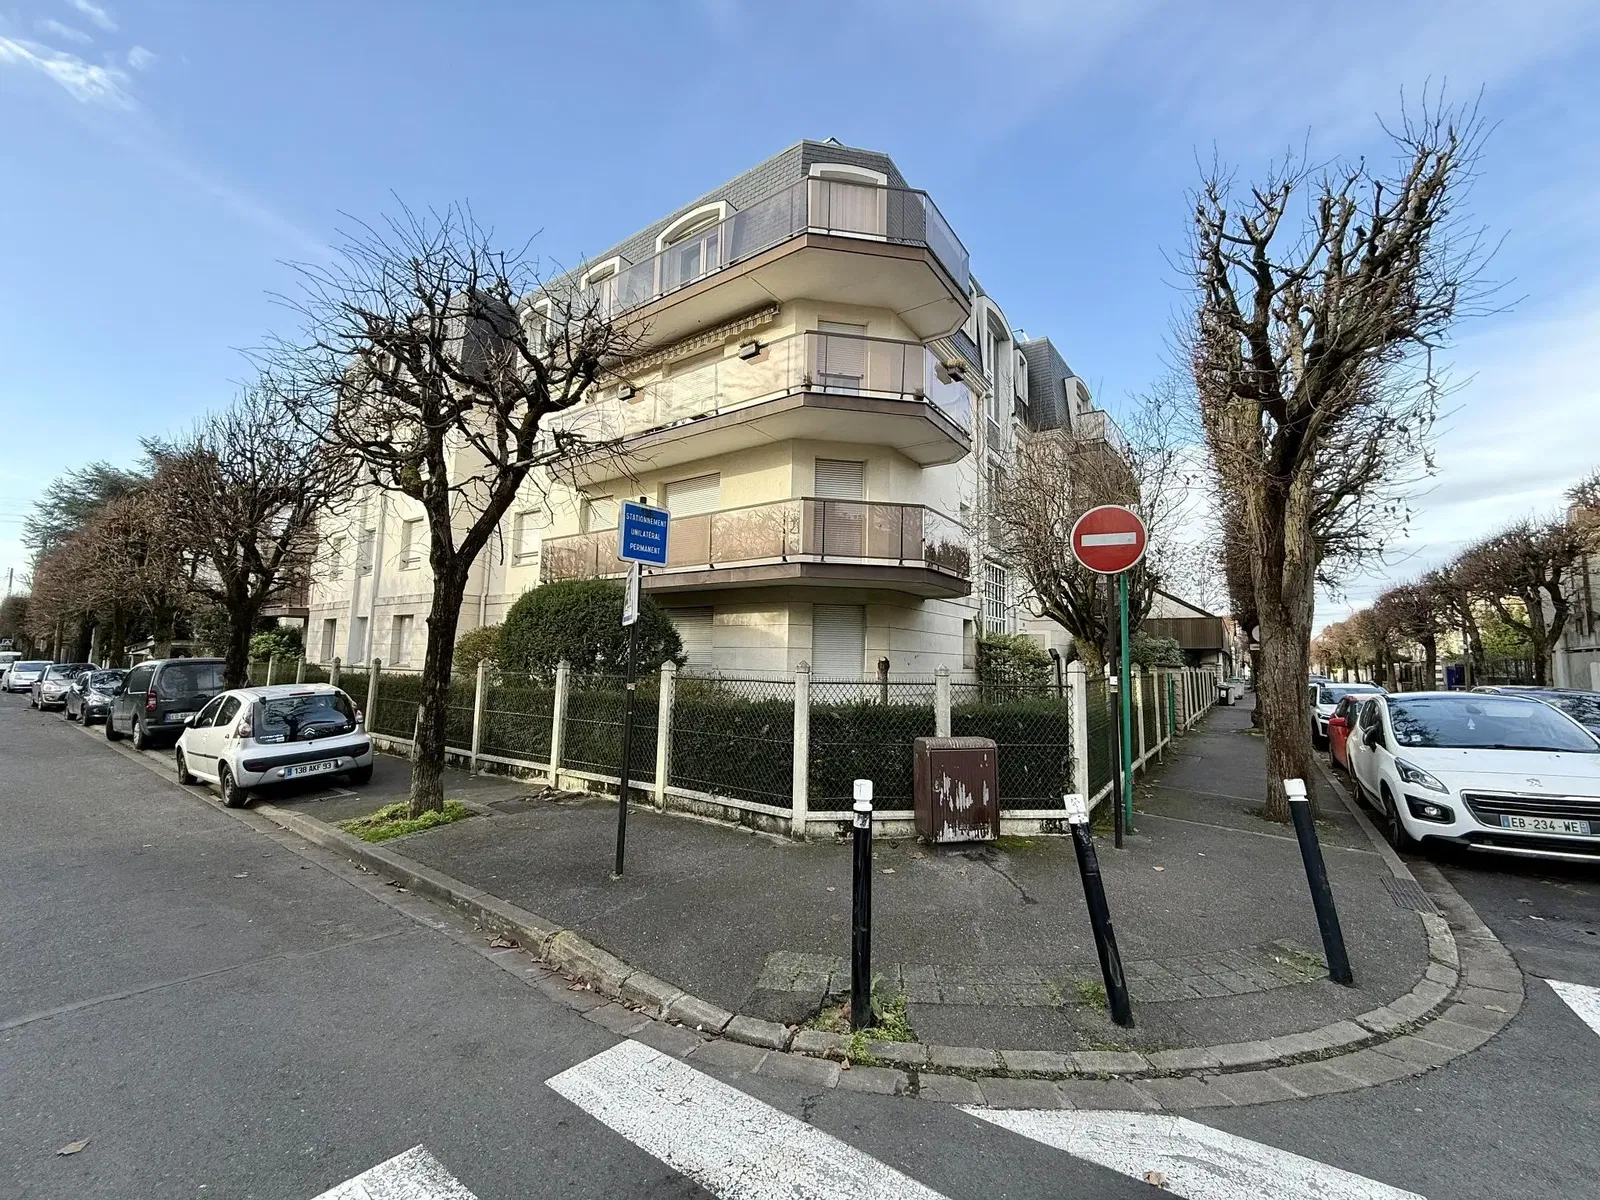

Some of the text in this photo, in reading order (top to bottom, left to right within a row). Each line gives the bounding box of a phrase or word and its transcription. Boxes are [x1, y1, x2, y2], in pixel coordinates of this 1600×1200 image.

[626, 512, 666, 527] STATIONNEMENT
[630, 528, 660, 540] UNILATÉRAL
[630, 542, 660, 554] PERMANENT
